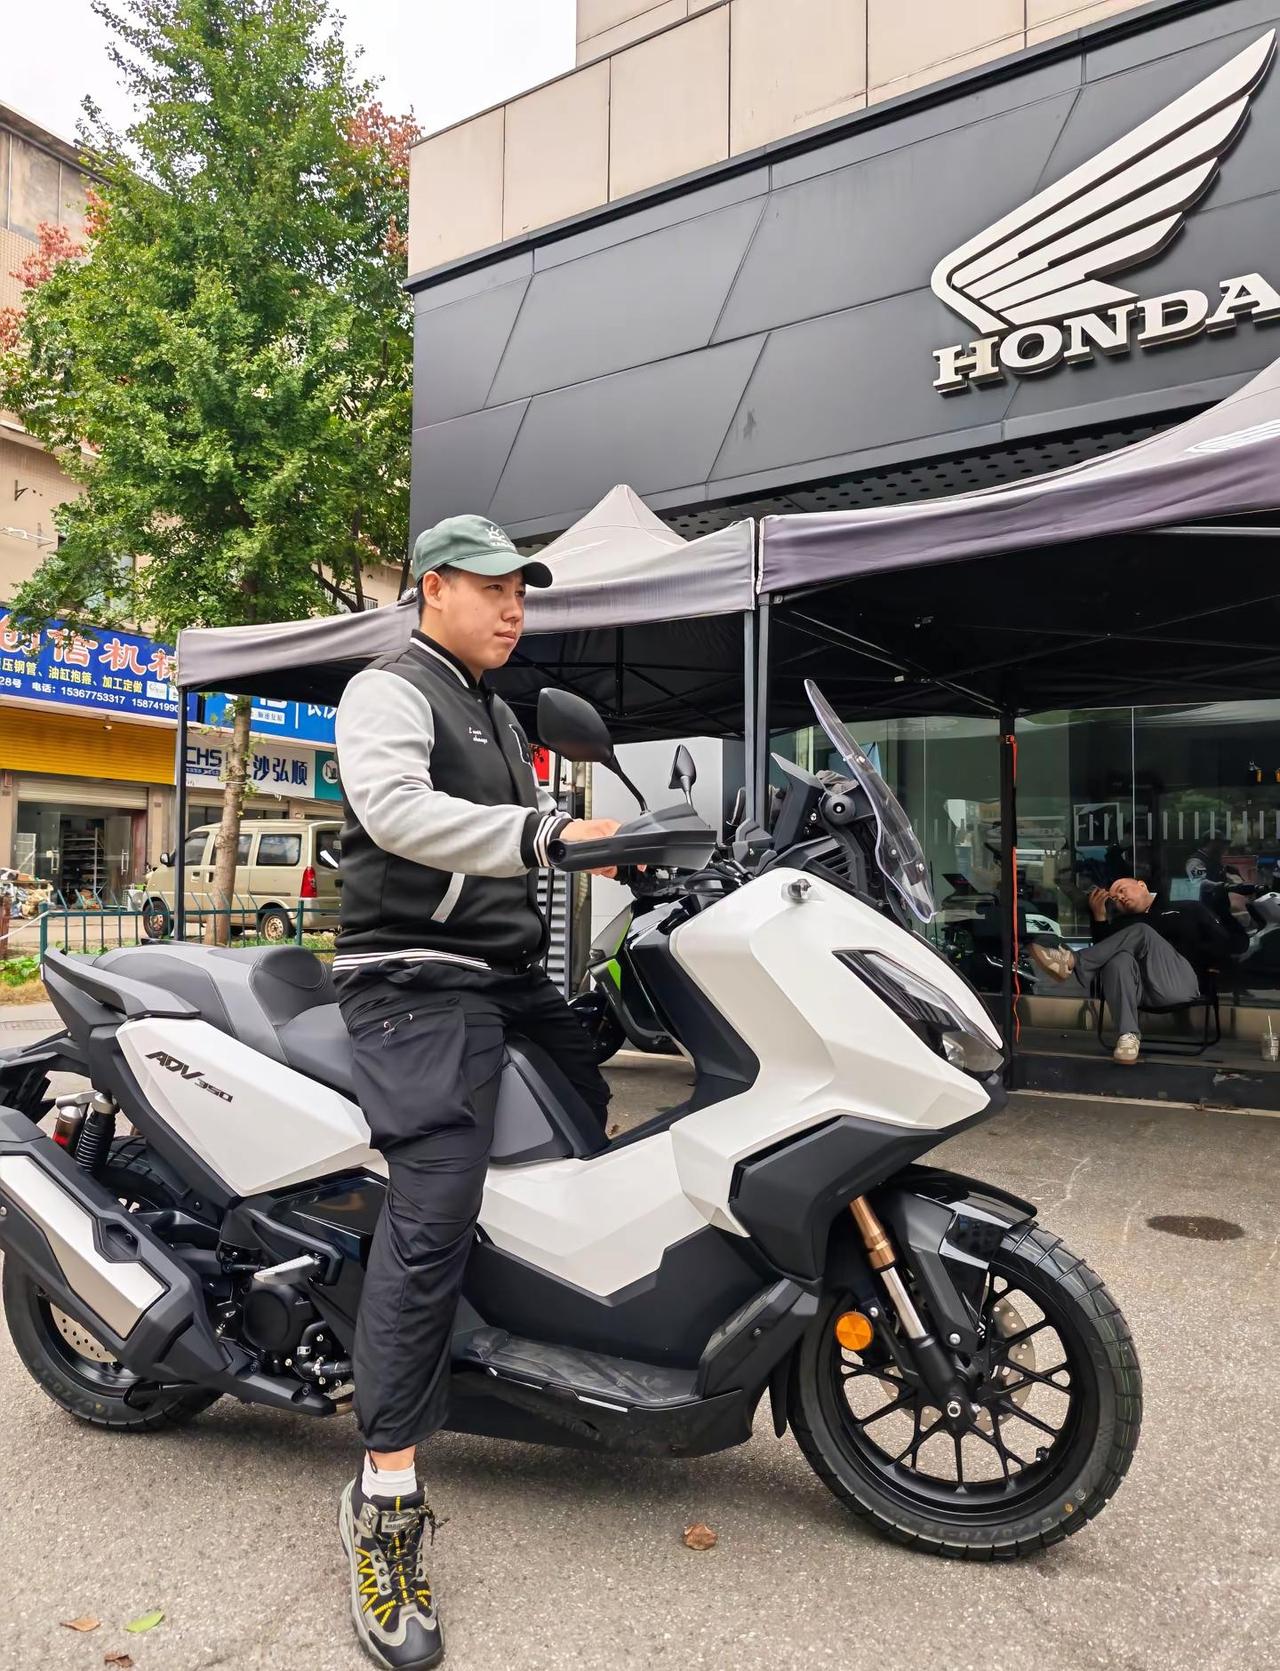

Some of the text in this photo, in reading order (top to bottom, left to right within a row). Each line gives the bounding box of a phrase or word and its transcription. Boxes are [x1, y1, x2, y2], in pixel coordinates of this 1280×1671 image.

[932, 272, 1280, 392] HONDA
[61, 686, 126, 705] 15367753317
[247, 753, 308, 786] 沙弘顺
[145, 1051, 233, 1103] ADV 350
